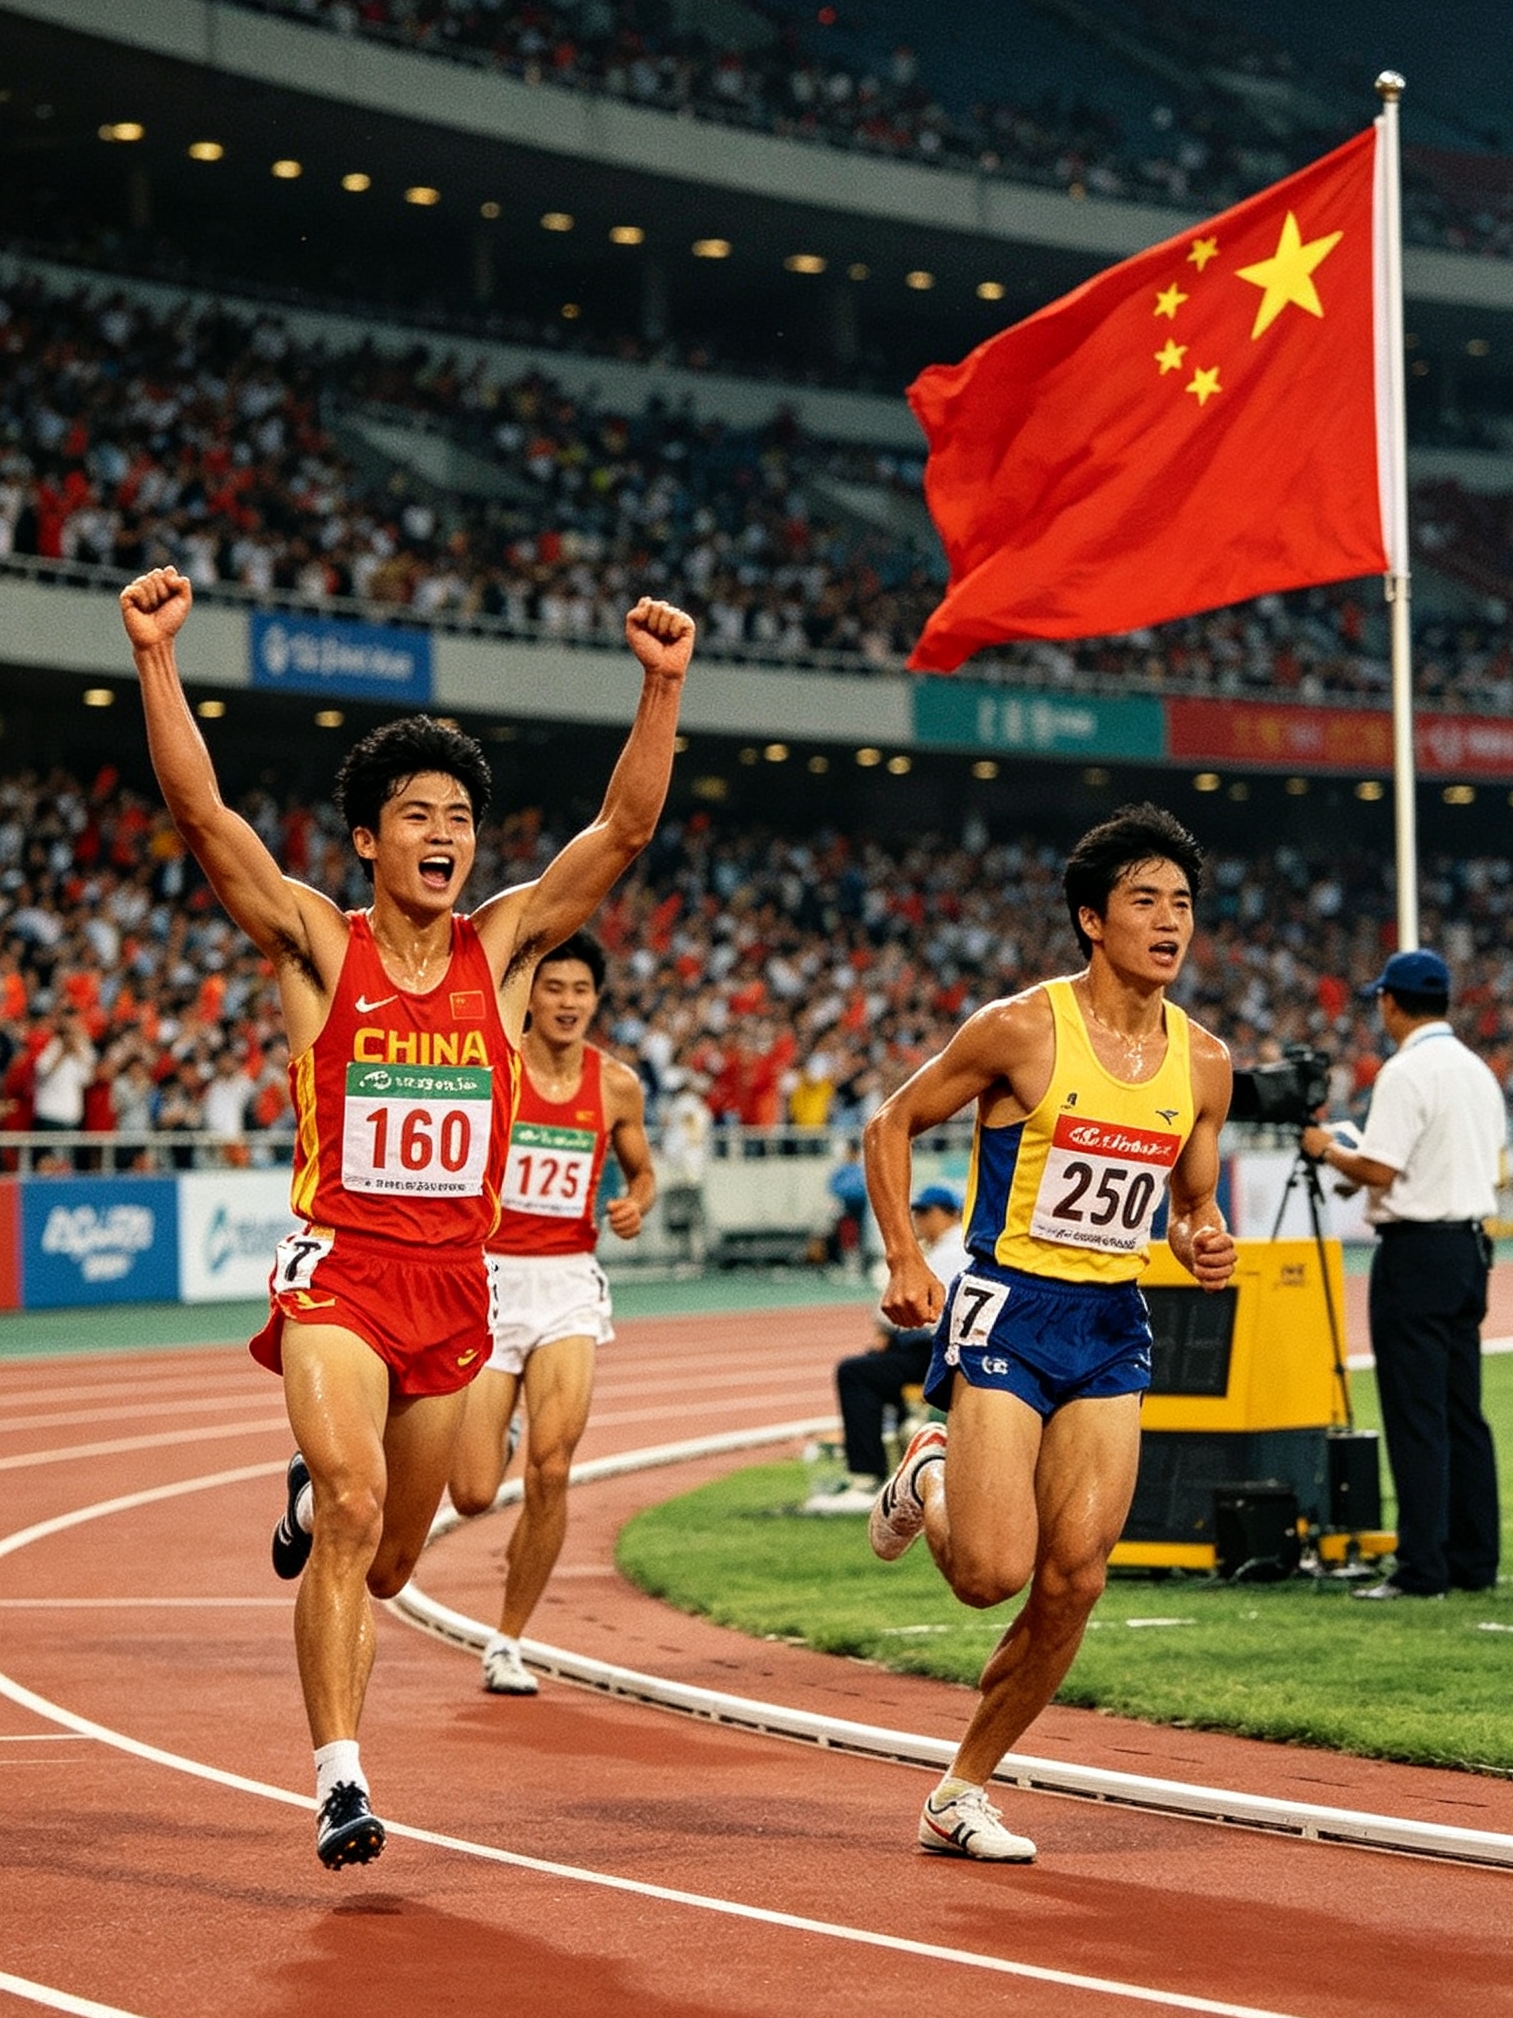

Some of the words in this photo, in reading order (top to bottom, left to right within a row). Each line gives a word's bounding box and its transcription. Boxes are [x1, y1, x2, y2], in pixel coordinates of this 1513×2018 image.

[354, 1027, 488, 1065] CHINA
[366, 1107, 471, 1172] 160
[517, 1154, 581, 1199] 125
[1051, 1161, 1155, 1229] 250
[285, 1241, 321, 1281] 7
[960, 1286, 995, 1339] 7
